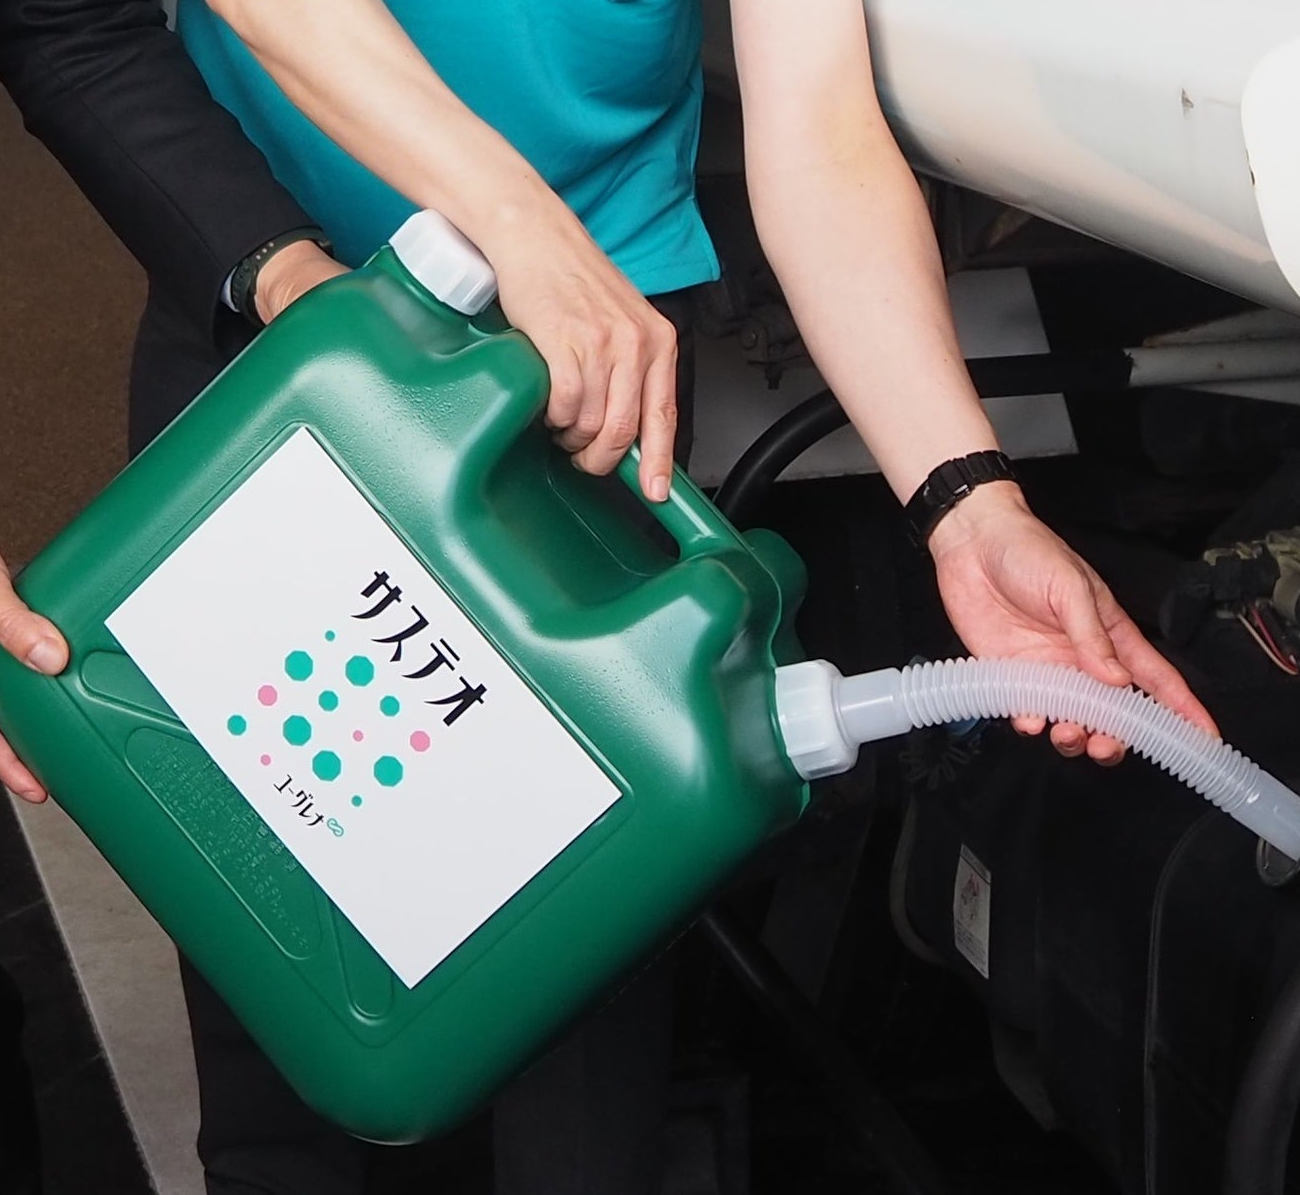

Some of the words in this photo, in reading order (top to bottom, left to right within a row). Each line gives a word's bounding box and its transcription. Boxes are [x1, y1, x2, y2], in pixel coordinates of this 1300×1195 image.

[350, 571, 488, 727] サステオ
[273, 774, 324, 826] ユーグレナ
